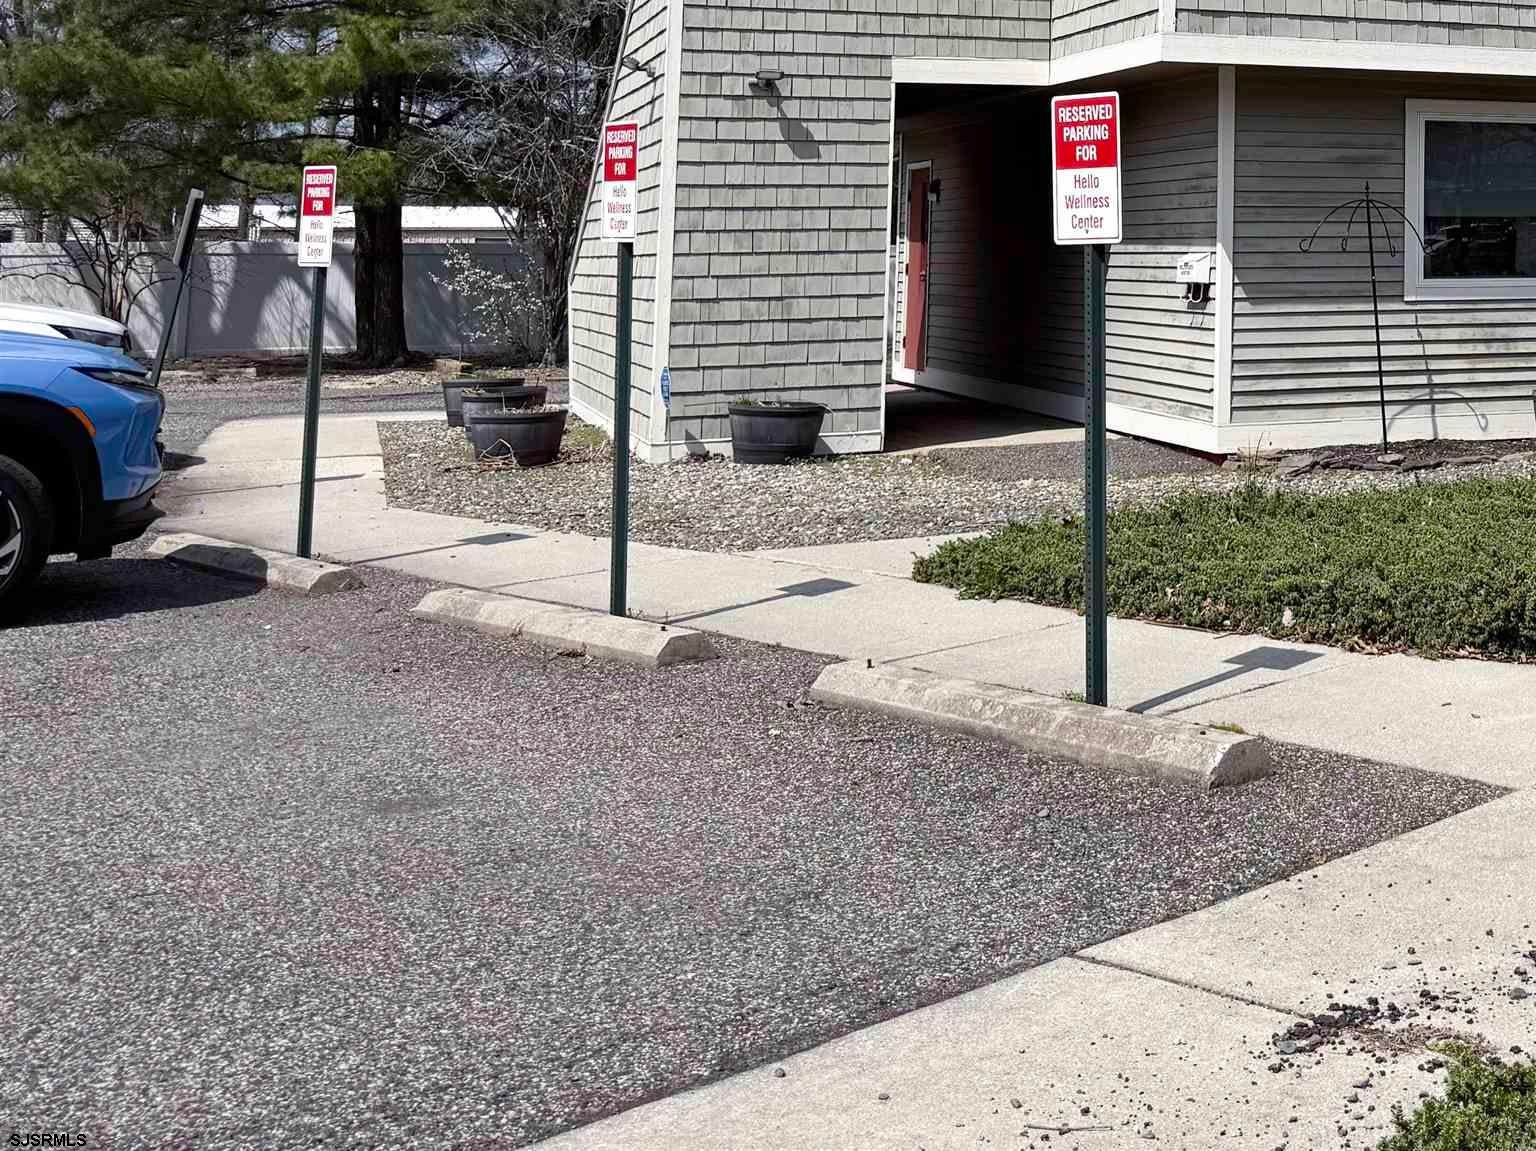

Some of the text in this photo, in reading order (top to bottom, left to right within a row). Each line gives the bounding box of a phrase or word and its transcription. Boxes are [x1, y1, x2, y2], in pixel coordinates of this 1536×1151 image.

[1058, 104, 1113, 122] RESERVED
[606, 129, 636, 144] RESERVED
[1063, 124, 1109, 142] PARKING
[608, 146, 633, 160] PARKING
[1075, 145, 1097, 161] FOR
[614, 162, 627, 176] FOR
[1073, 174, 1099, 189] Hello
[612, 184, 627, 198] Hello
[312, 200, 324, 211] FOR
[607, 202, 632, 214] Wellness
[1064, 195, 1110, 209] Wellness
[1071, 214, 1104, 230] Center
